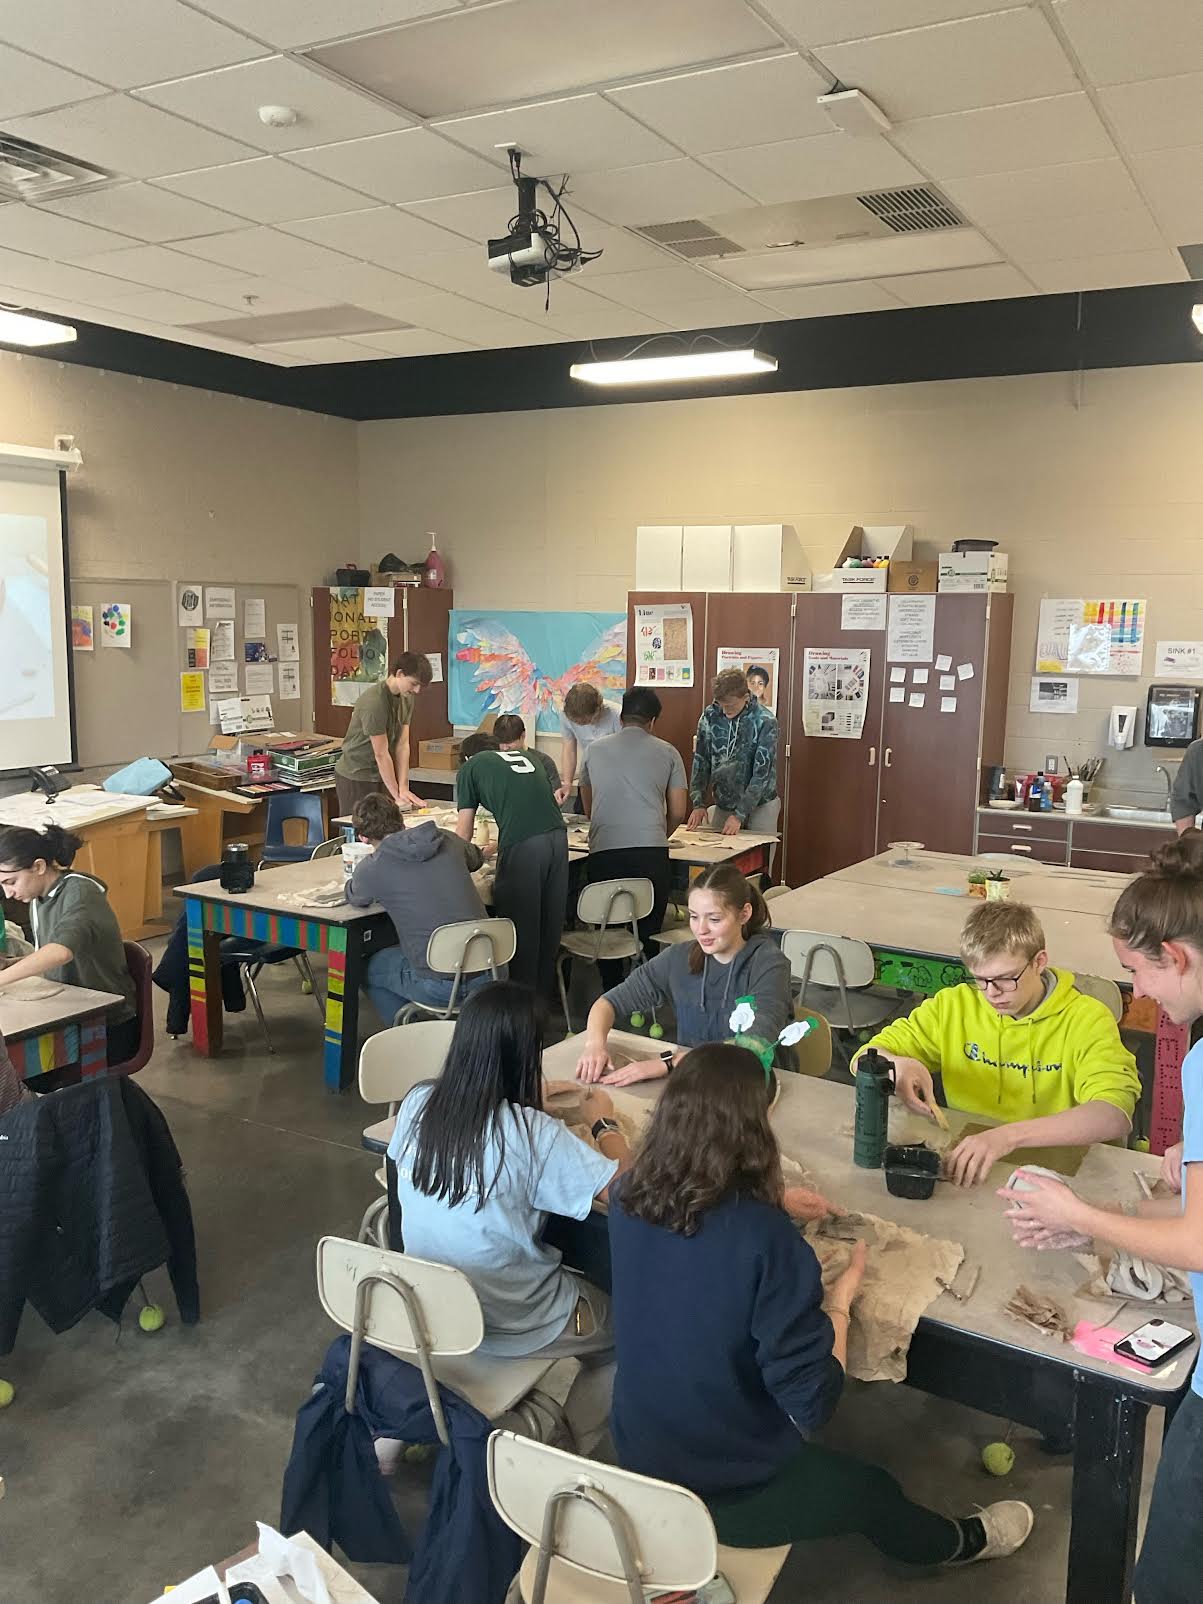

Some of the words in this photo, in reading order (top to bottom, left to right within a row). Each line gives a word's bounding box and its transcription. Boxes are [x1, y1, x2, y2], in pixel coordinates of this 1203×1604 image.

[330, 593, 358, 605] NAT
[331, 647, 375, 660] FOLIO
[496, 751, 536, 774] 5
[964, 1043, 1063, 1079] Champion
